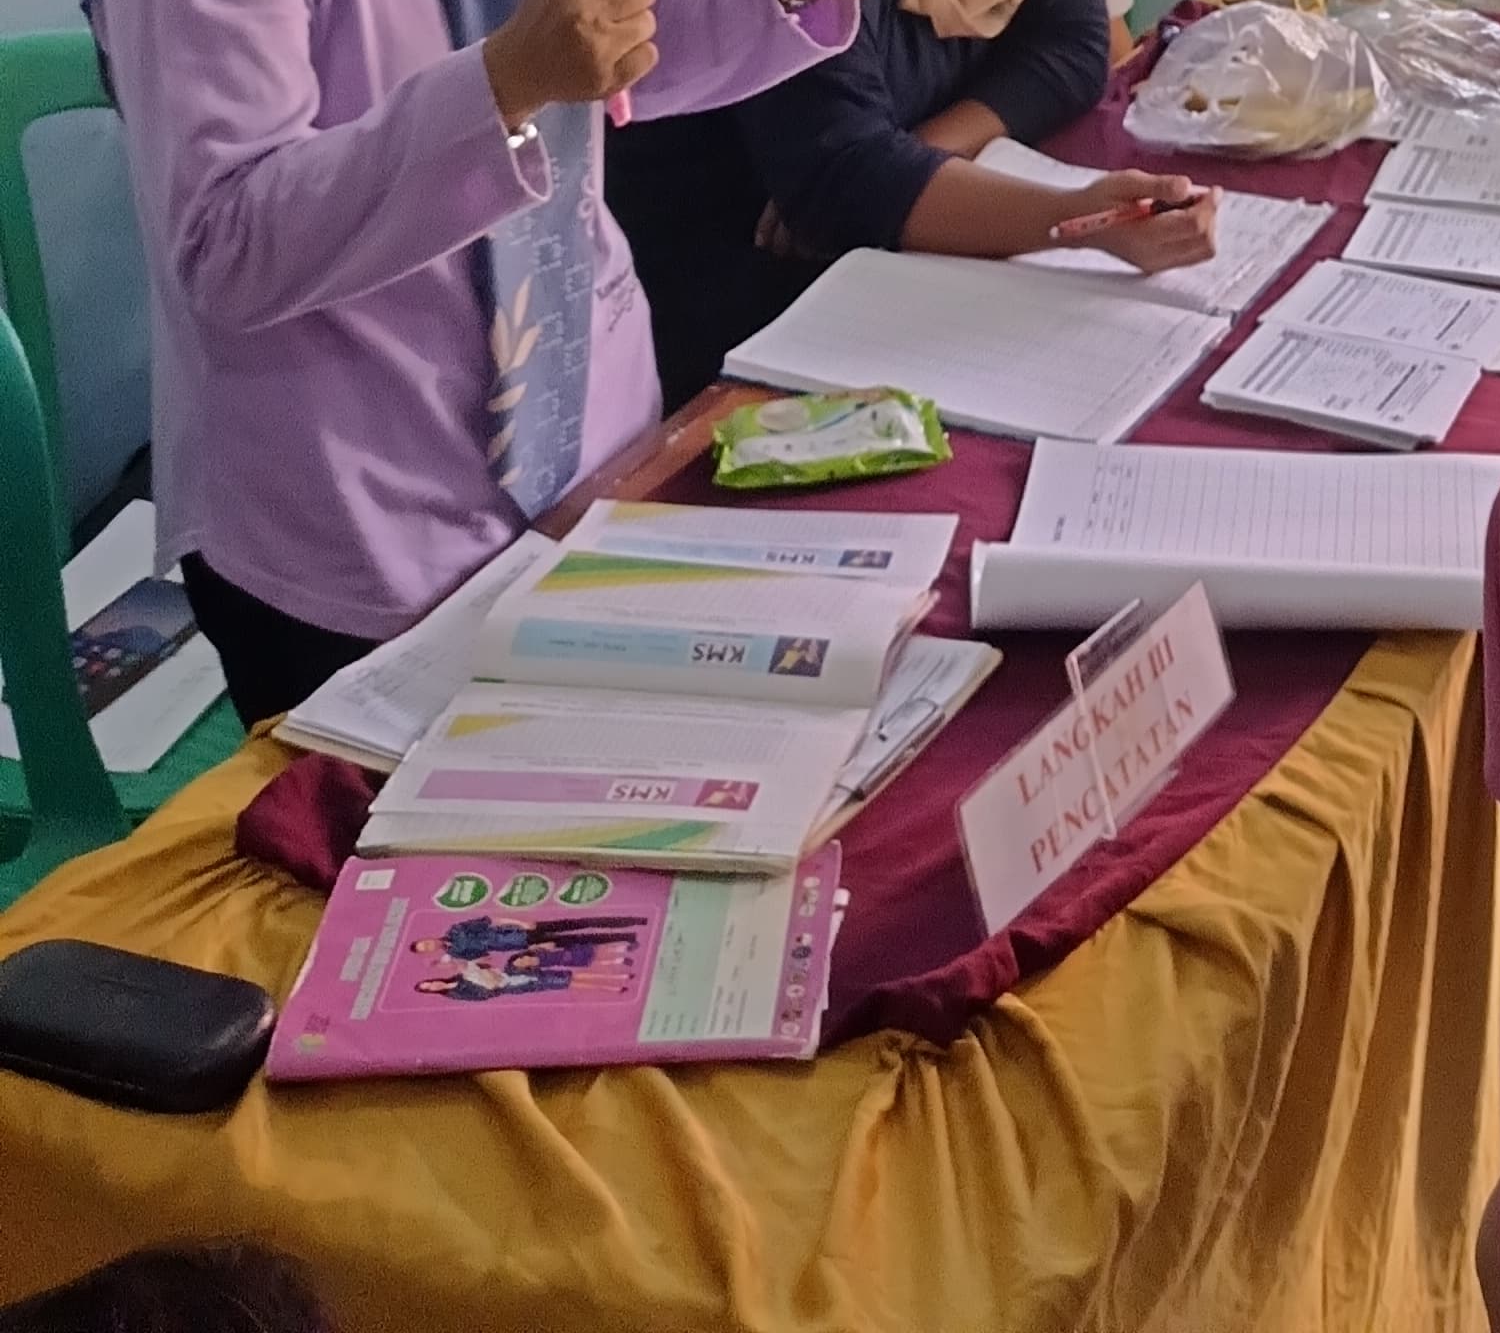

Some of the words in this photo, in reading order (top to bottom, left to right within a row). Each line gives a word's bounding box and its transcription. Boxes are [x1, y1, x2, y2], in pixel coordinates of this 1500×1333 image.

[691, 642, 747, 664] KMS
[1015, 668, 1147, 806] LANGKAH
[1146, 634, 1176, 680] III
[611, 783, 672, 802] KMS
[1029, 689, 1195, 875] PENCATATAN
